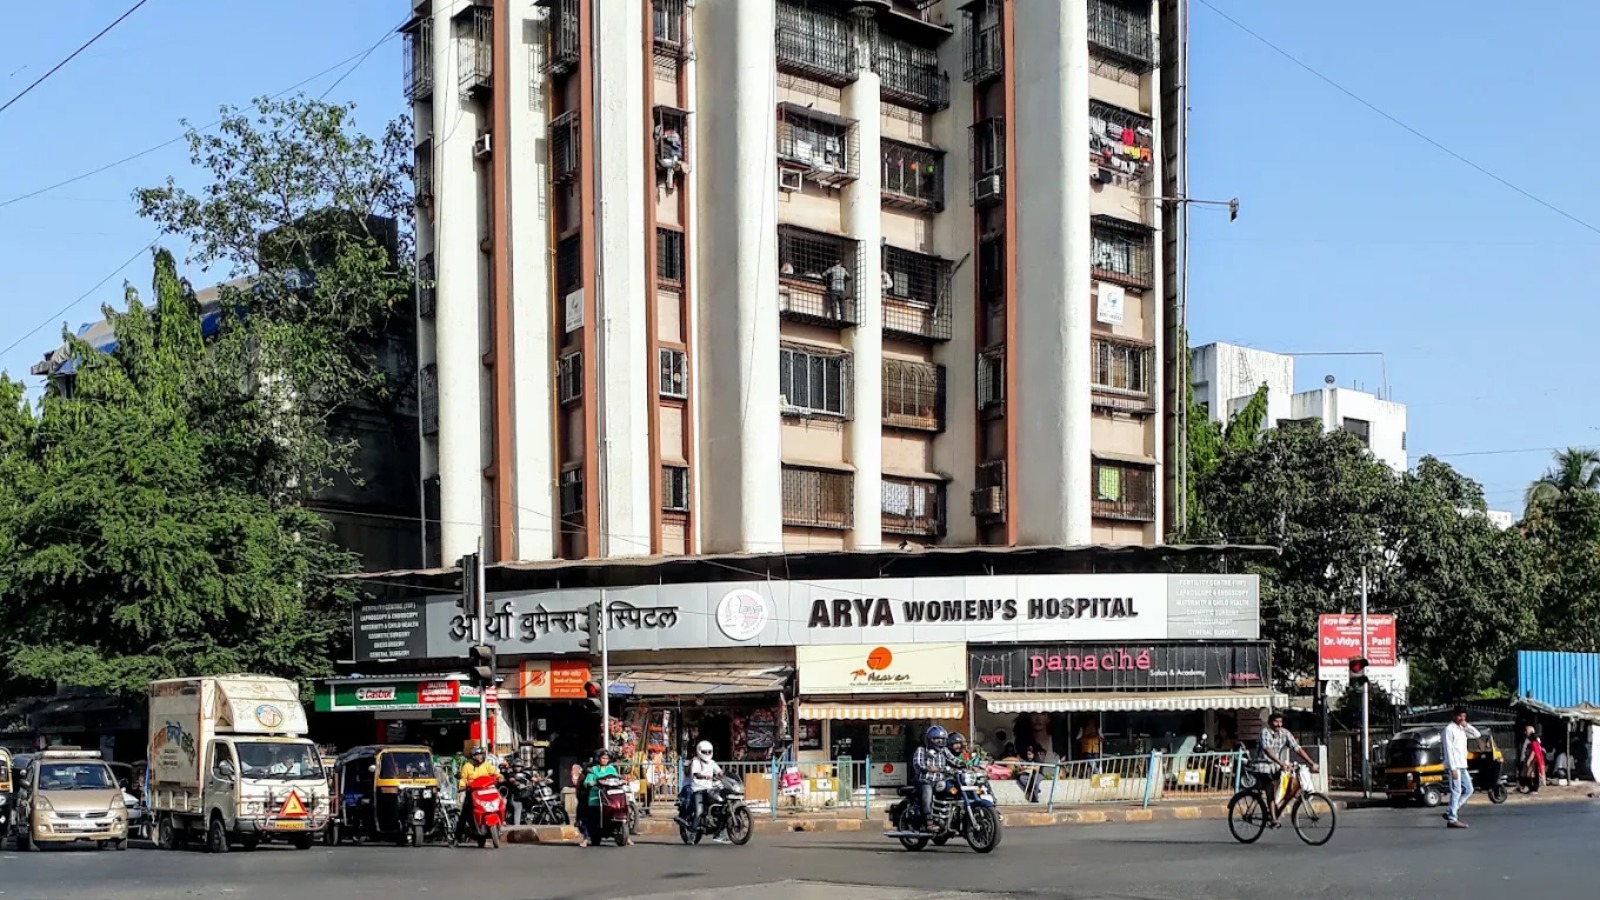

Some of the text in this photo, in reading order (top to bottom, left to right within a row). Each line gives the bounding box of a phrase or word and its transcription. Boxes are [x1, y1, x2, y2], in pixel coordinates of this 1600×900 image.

[808, 597, 1138, 627] ARYA WOMEN'S HOSPITAL
[1031, 648, 1150, 677] panaché
[1150, 668, 1206, 678] Salon & Academy
